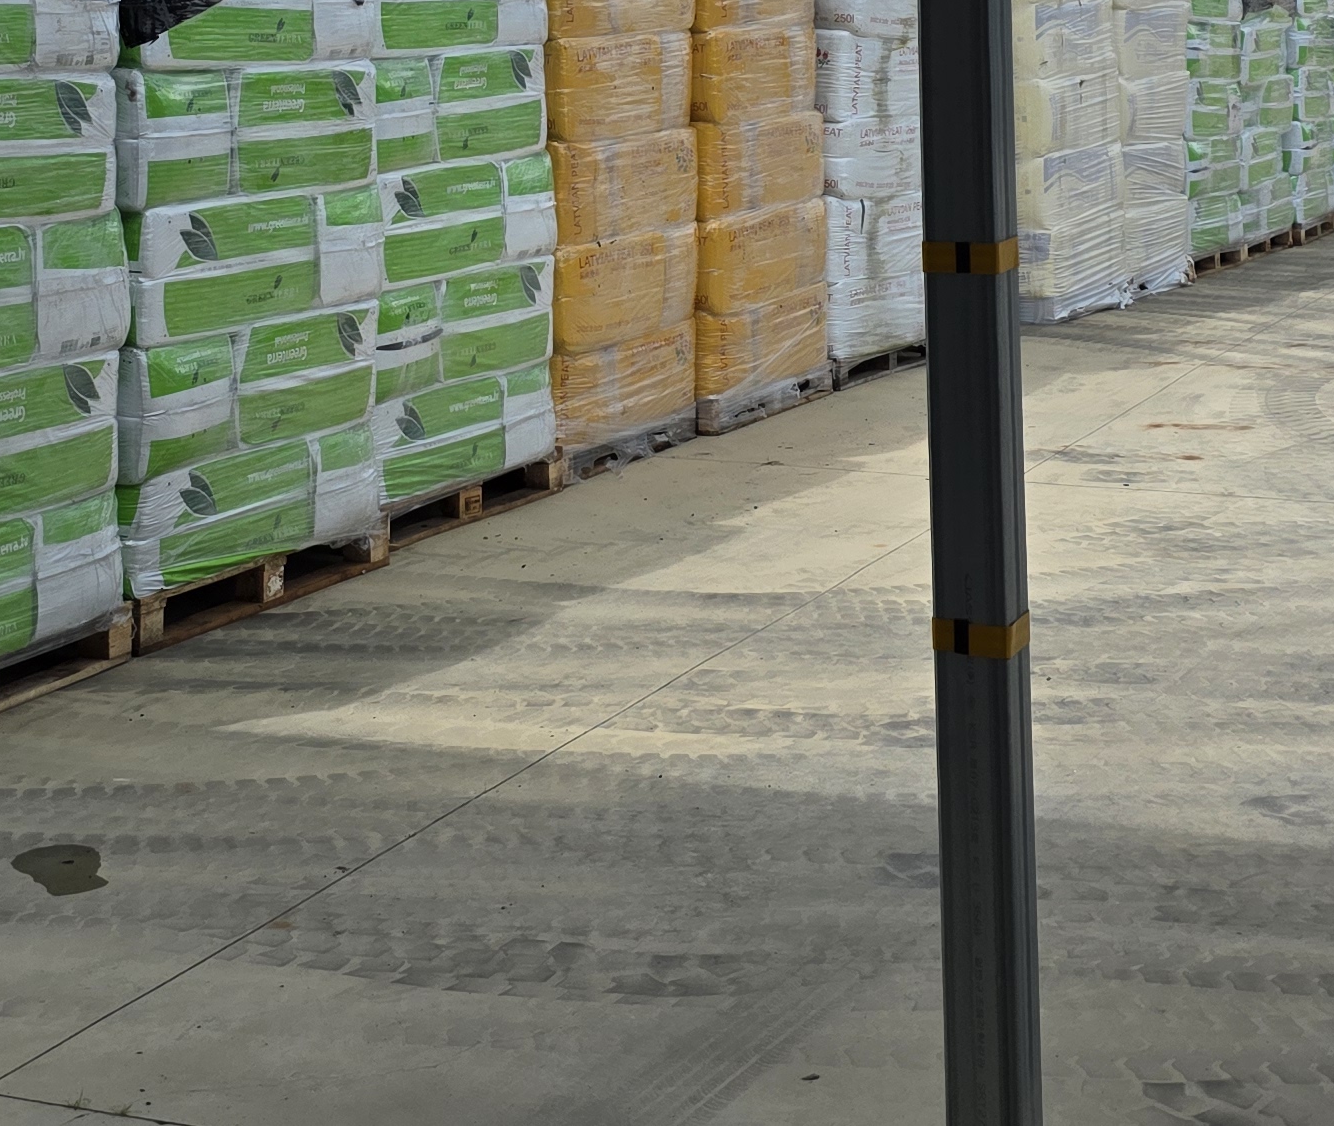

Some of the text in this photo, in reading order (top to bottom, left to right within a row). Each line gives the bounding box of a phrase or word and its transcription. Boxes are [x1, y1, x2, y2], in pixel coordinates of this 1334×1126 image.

[834, 13, 855, 23] 250l
[852, 72, 861, 115] LATVIAN
[823, 127, 843, 138] EAT
[824, 179, 839, 189] 50l
[571, 180, 581, 235] LATVIAN
